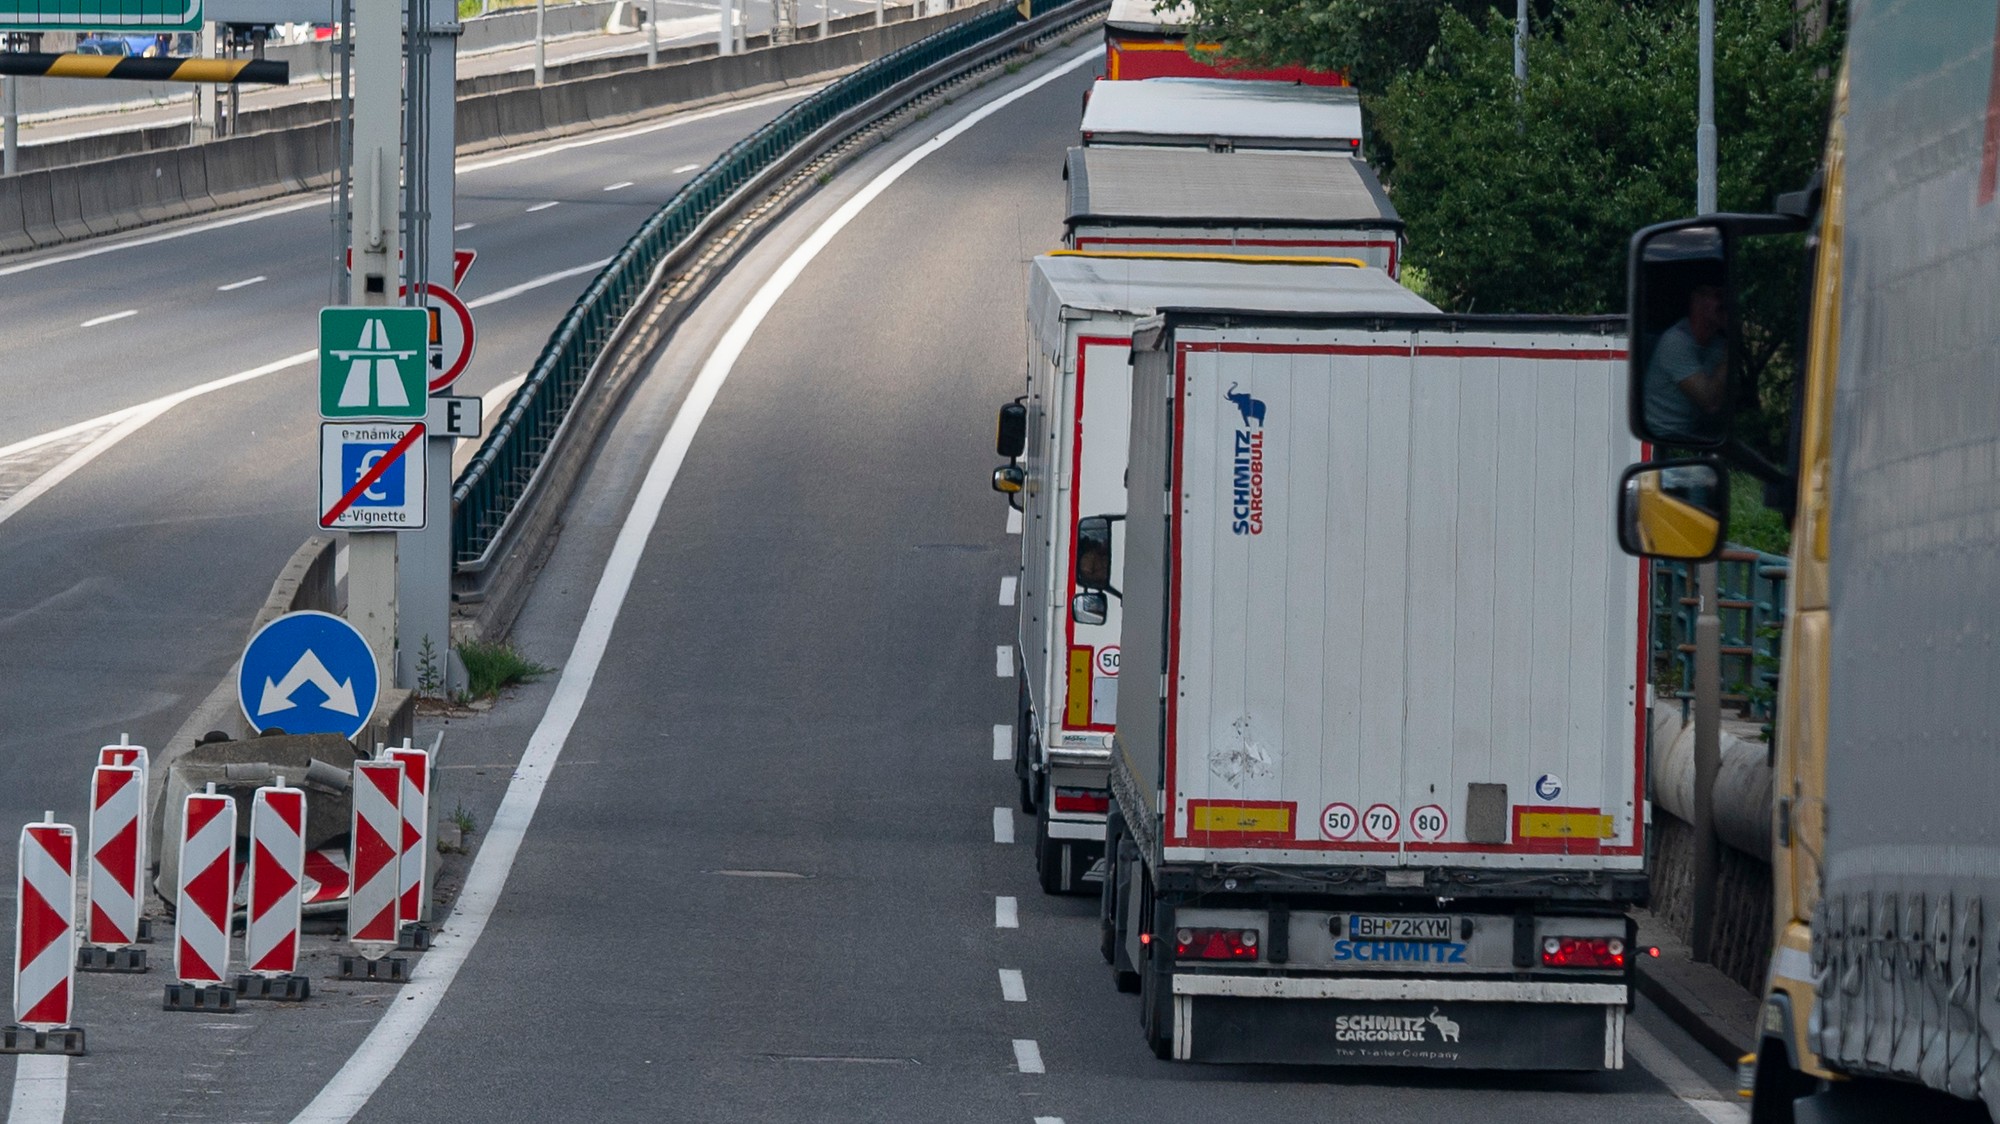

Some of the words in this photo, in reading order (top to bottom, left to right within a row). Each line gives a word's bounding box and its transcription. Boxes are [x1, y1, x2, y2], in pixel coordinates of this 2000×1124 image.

[447, 401, 461, 433] E
[342, 427, 405, 440] e-známka
[1233, 430, 1249, 535] SCHMITZ
[1251, 431, 1263, 535] CARGOBULL
[339, 510, 406, 524] e-Vignette
[1103, 654, 1120, 667] 50
[1329, 813, 1350, 829] 50
[1371, 814, 1392, 830] 70
[1419, 815, 1440, 831] 80
[1361, 919, 1386, 934] BH
[1335, 941, 1466, 962] SCHMITZ
[1335, 1015, 1426, 1031] SCHMITZ
[1335, 1030, 1425, 1042] CARGOBULL
[1402, 1049, 1459, 1061] Company
